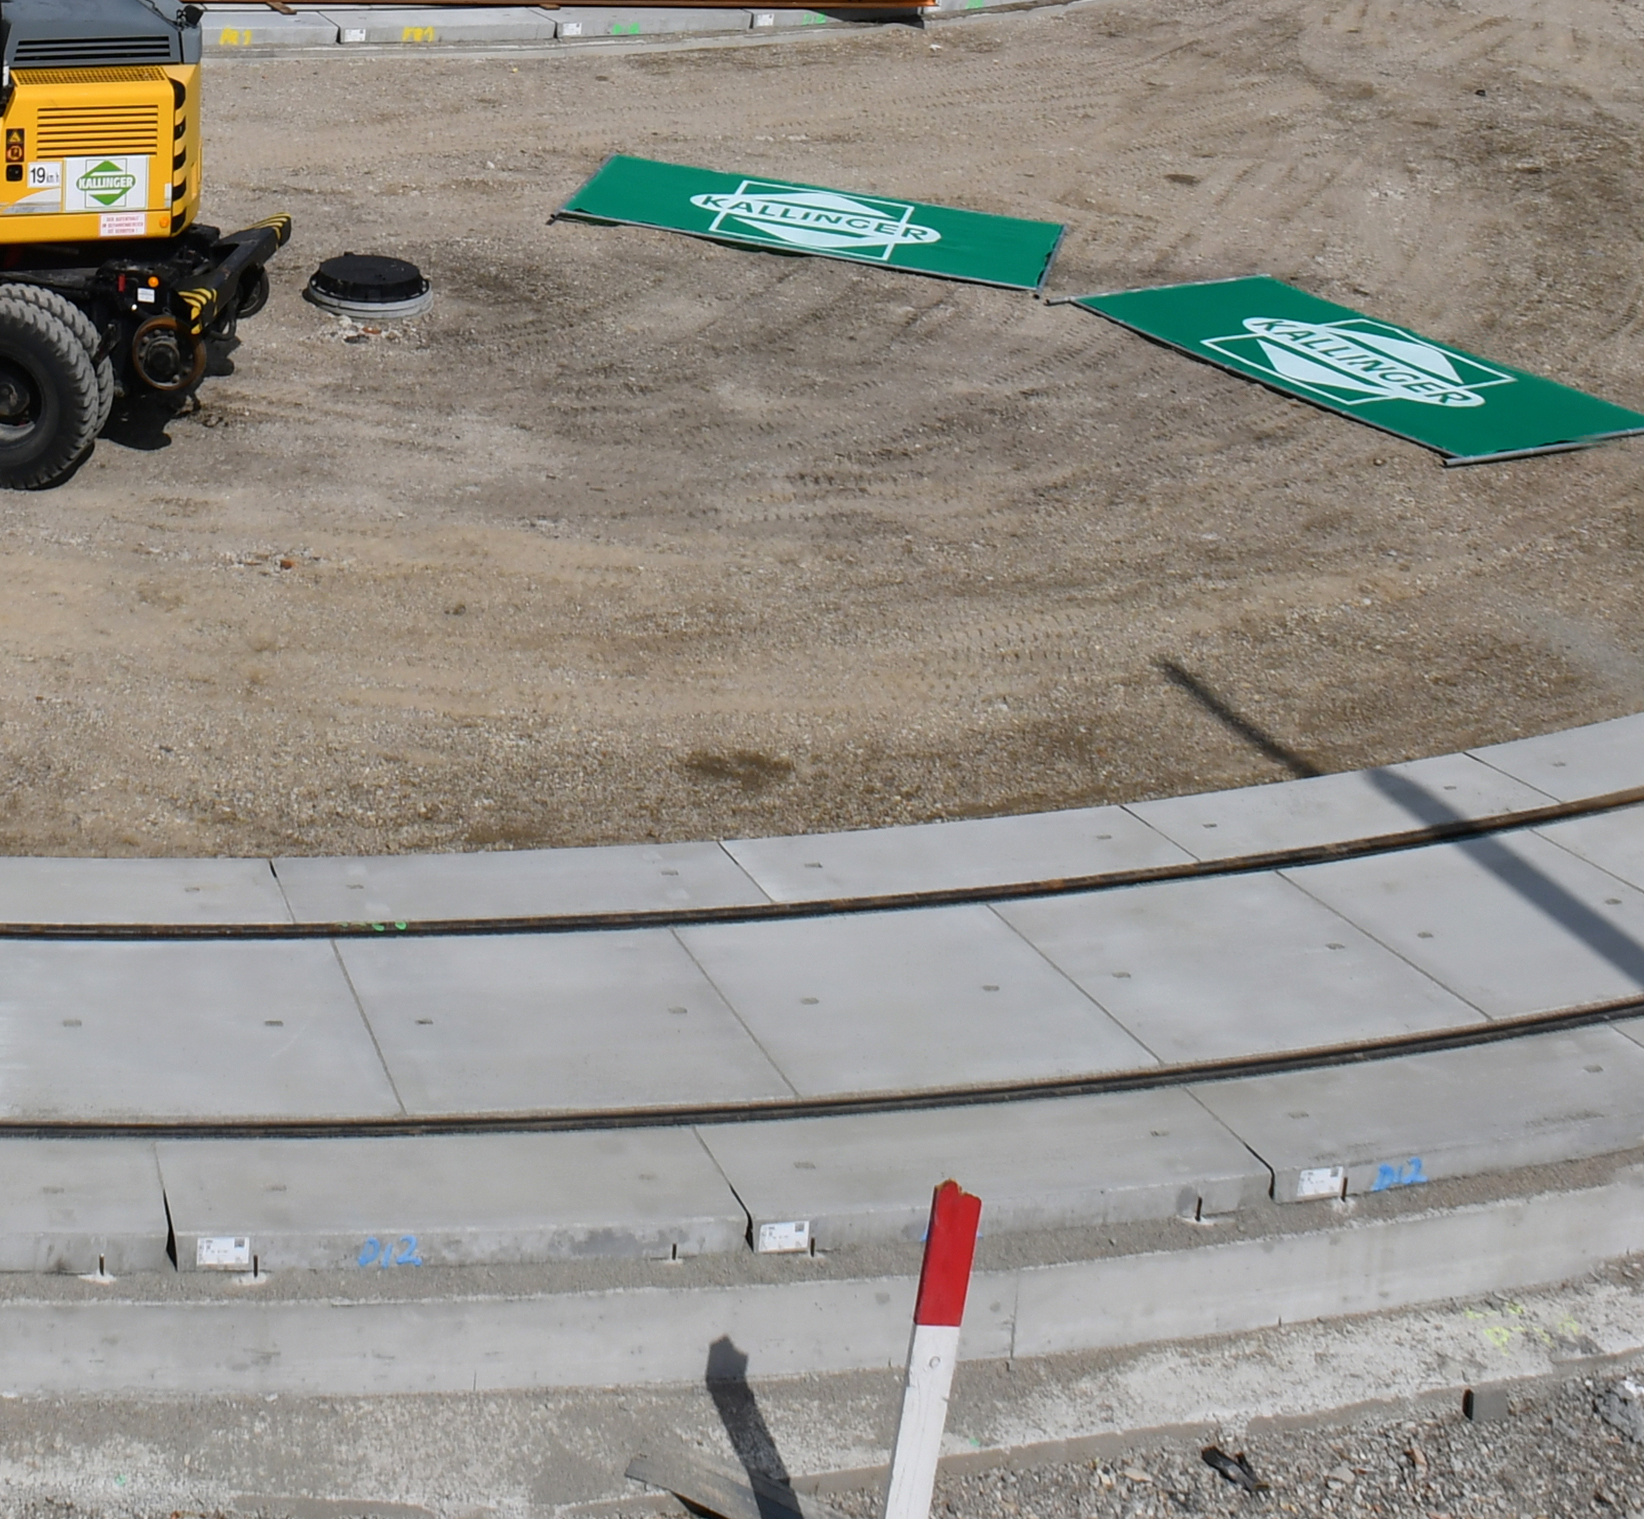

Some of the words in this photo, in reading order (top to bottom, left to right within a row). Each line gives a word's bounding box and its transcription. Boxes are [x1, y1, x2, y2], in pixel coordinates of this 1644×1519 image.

[29, 166, 46, 184] 19
[78, 176, 134, 190] KALLINGER
[701, 194, 929, 241] KALLINGER
[1252, 319, 1473, 405] KALLINGER
[357, 1233, 423, 1270] D12
